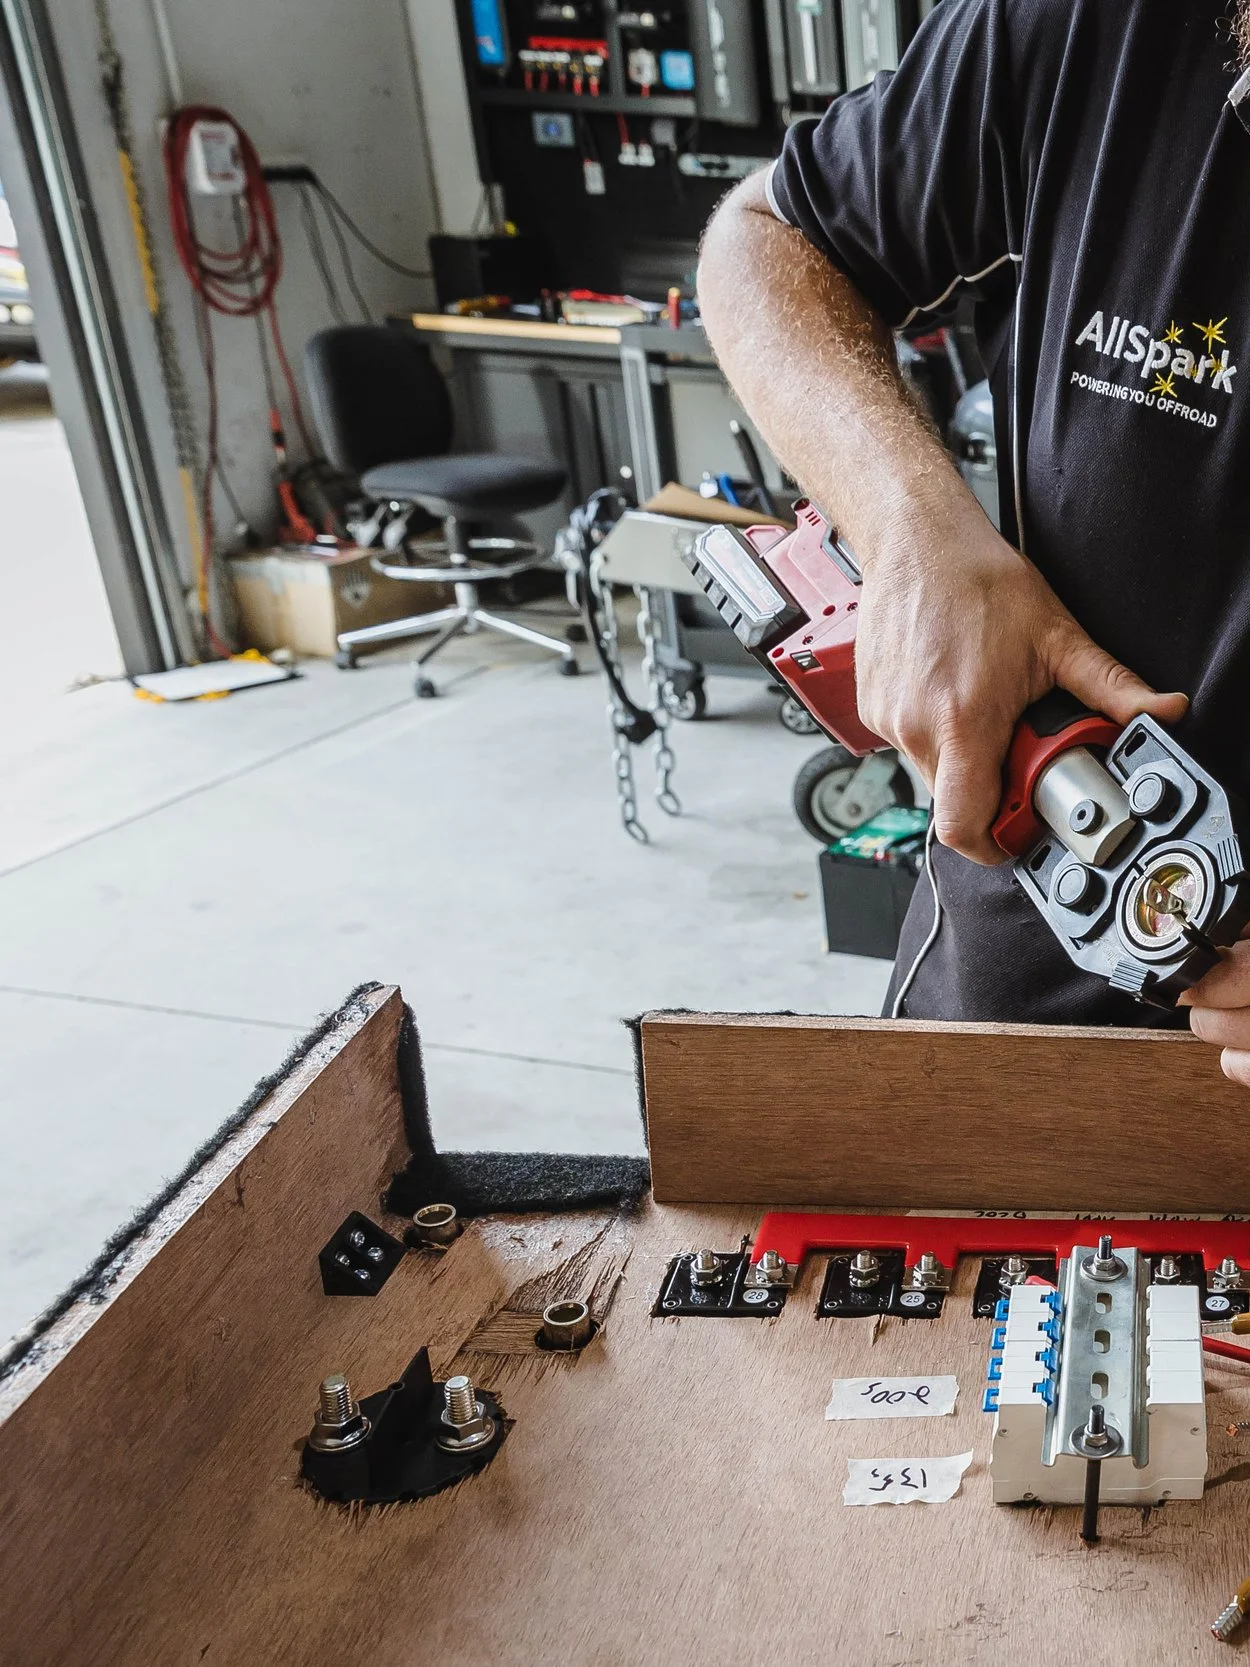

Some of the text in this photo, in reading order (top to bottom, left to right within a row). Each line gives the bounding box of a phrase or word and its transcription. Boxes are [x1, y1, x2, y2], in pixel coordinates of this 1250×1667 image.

[1075, 311, 1237, 394] AllSpark
[1157, 397, 1218, 428] OFFROAD
[747, 1292, 764, 1300] 28
[905, 1295, 920, 1303] 25
[1211, 1300, 1226, 1308] 27
